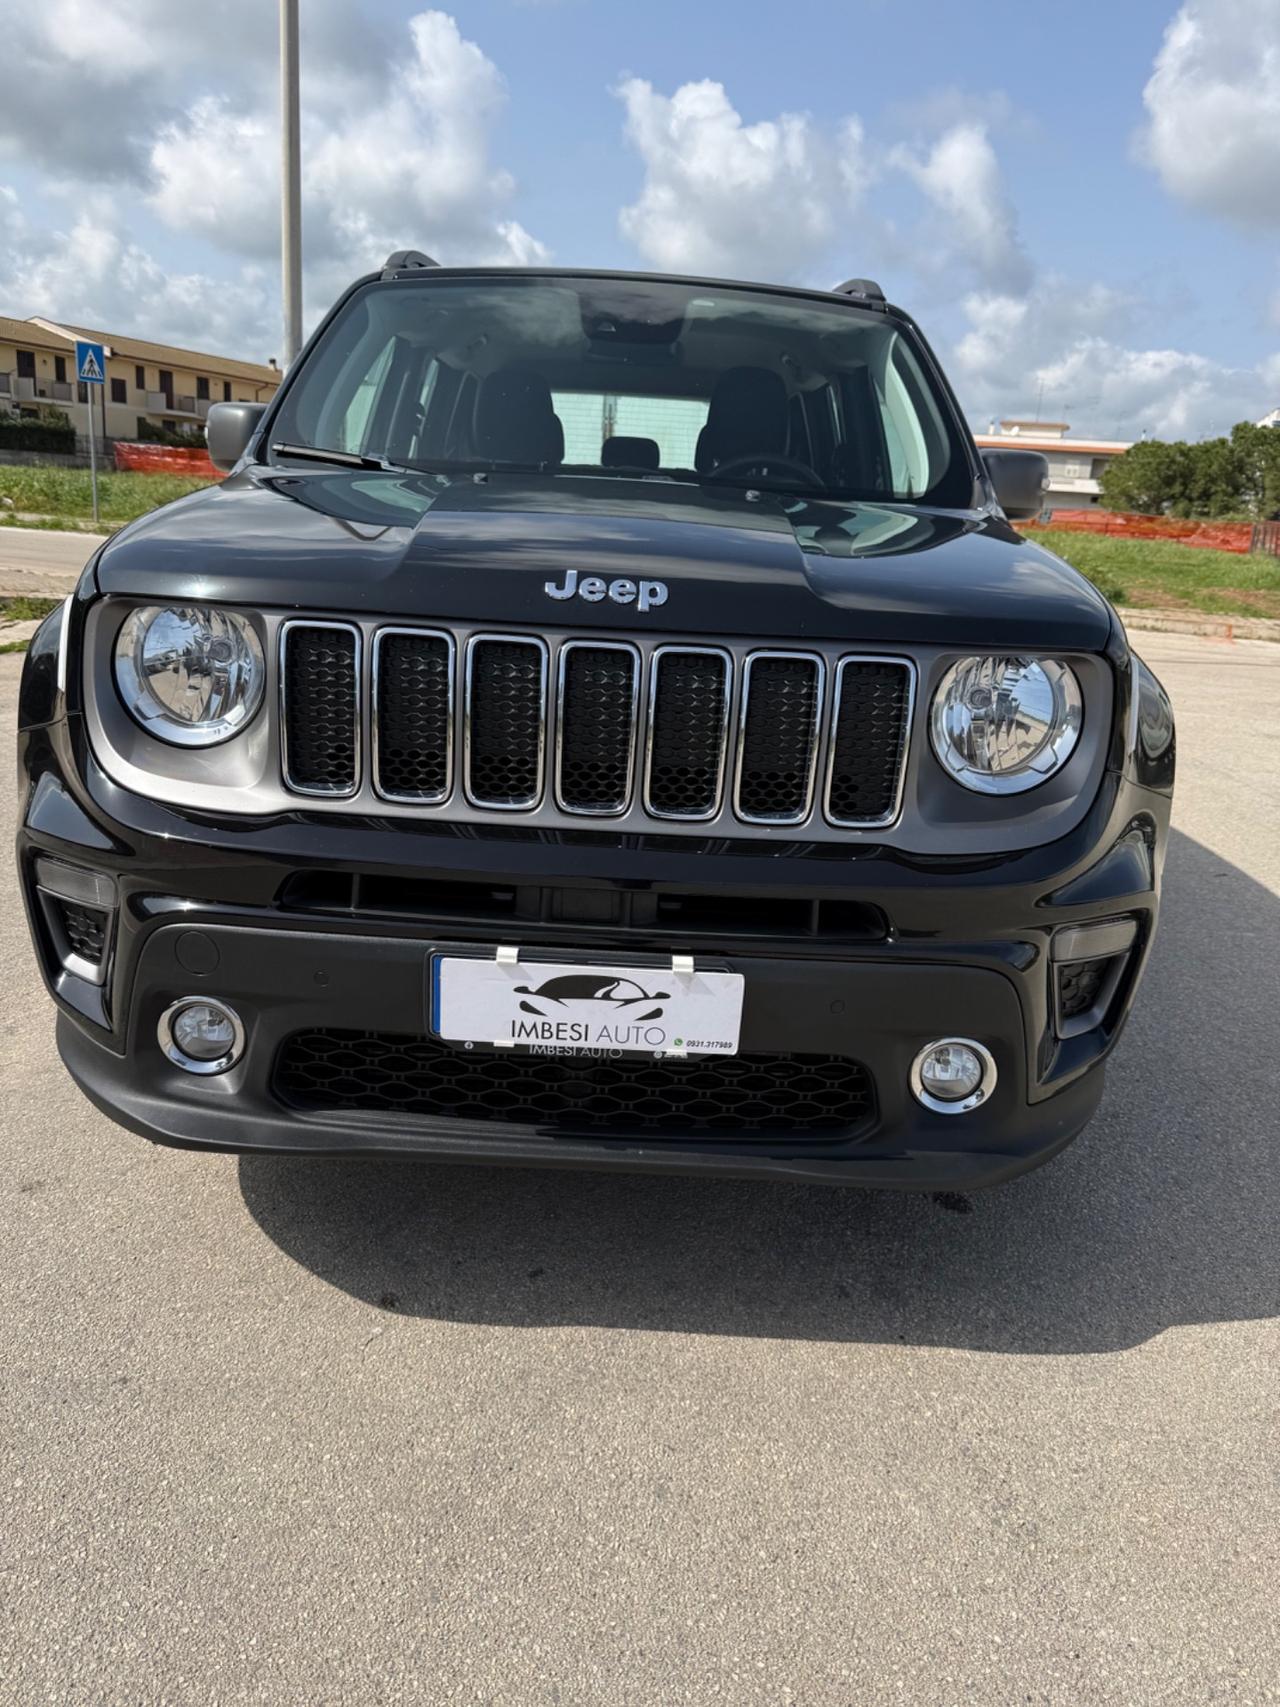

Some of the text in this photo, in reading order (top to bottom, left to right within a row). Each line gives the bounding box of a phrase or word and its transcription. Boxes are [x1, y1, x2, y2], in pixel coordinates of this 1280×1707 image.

[544, 569, 669, 612] Jeep
[511, 1019, 666, 1046] IMBESI AUTO
[528, 1043, 624, 1060] IMBESI AUTO
